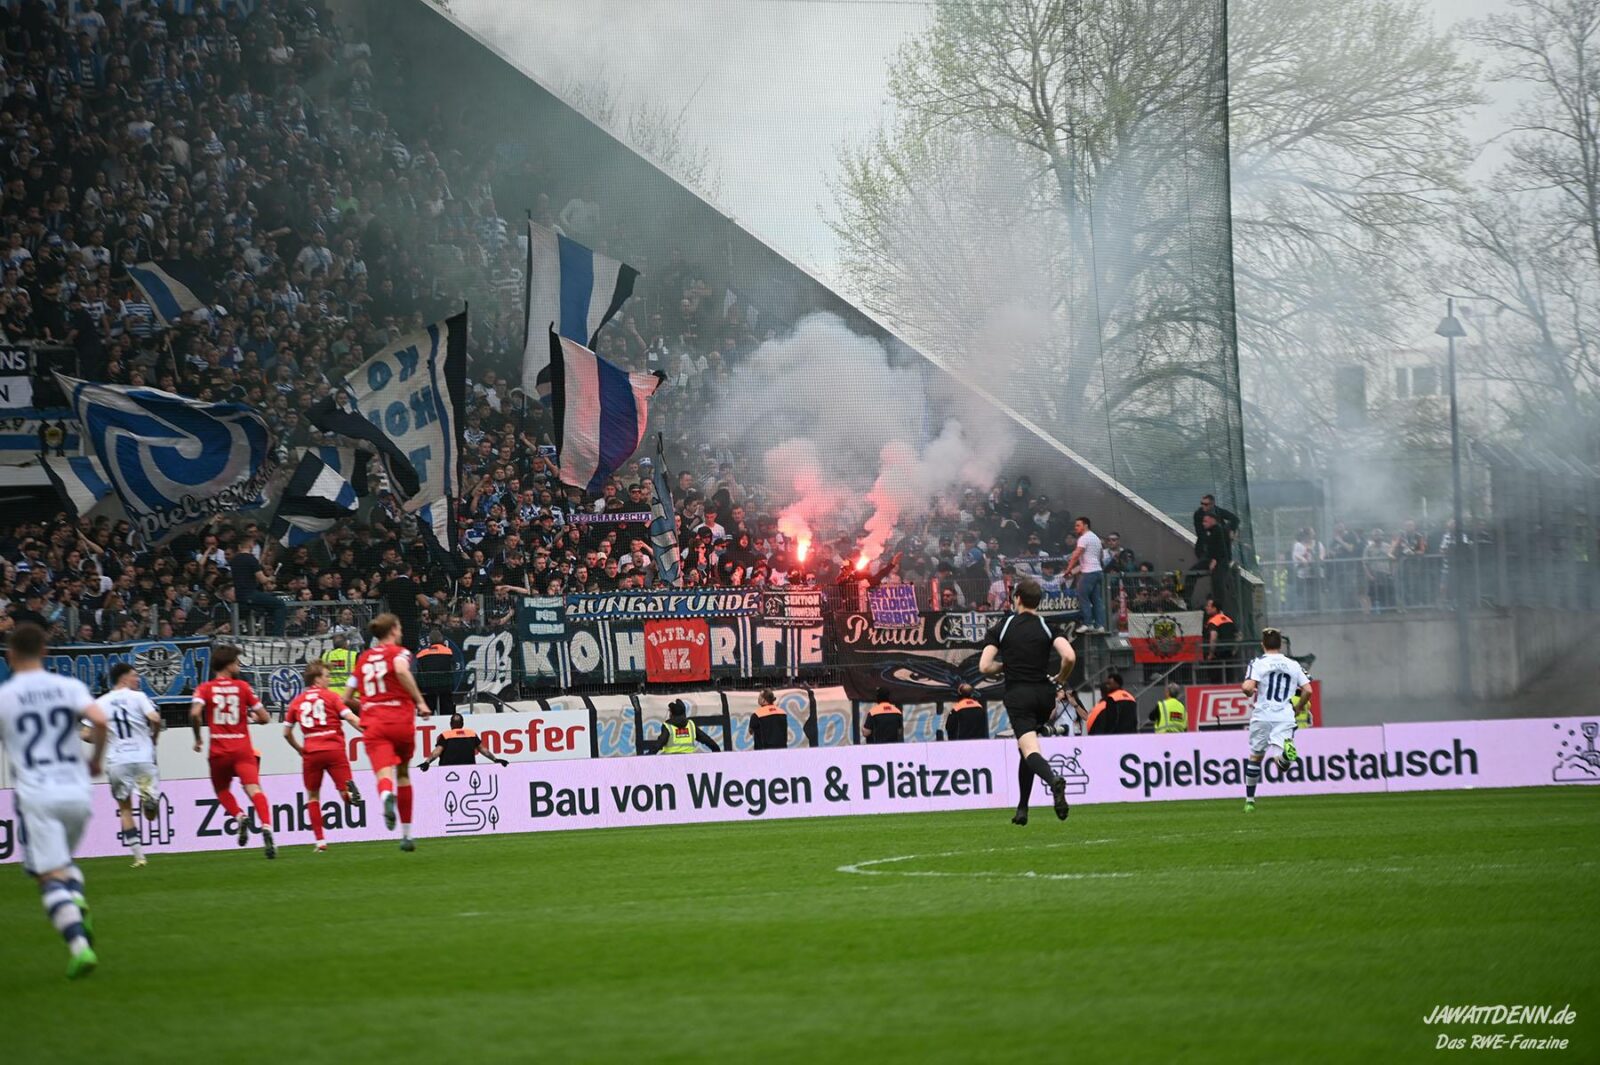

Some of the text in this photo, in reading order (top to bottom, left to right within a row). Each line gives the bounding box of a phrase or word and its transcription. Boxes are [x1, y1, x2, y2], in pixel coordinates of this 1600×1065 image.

[565, 592, 759, 615] JUNGSPUNDE
[522, 626, 824, 677] KOHRTE
[647, 626, 706, 647] ULTRAS
[662, 648, 691, 671] MZ
[361, 660, 387, 697] 27
[1266, 671, 1292, 703] 10
[113, 708, 133, 740] 11
[212, 694, 240, 725] 23
[300, 699, 326, 728] 24
[16, 705, 77, 768] 22
[416, 719, 586, 759] Tnsfer
[529, 761, 993, 818] Bau von Wegen & Plätzen
